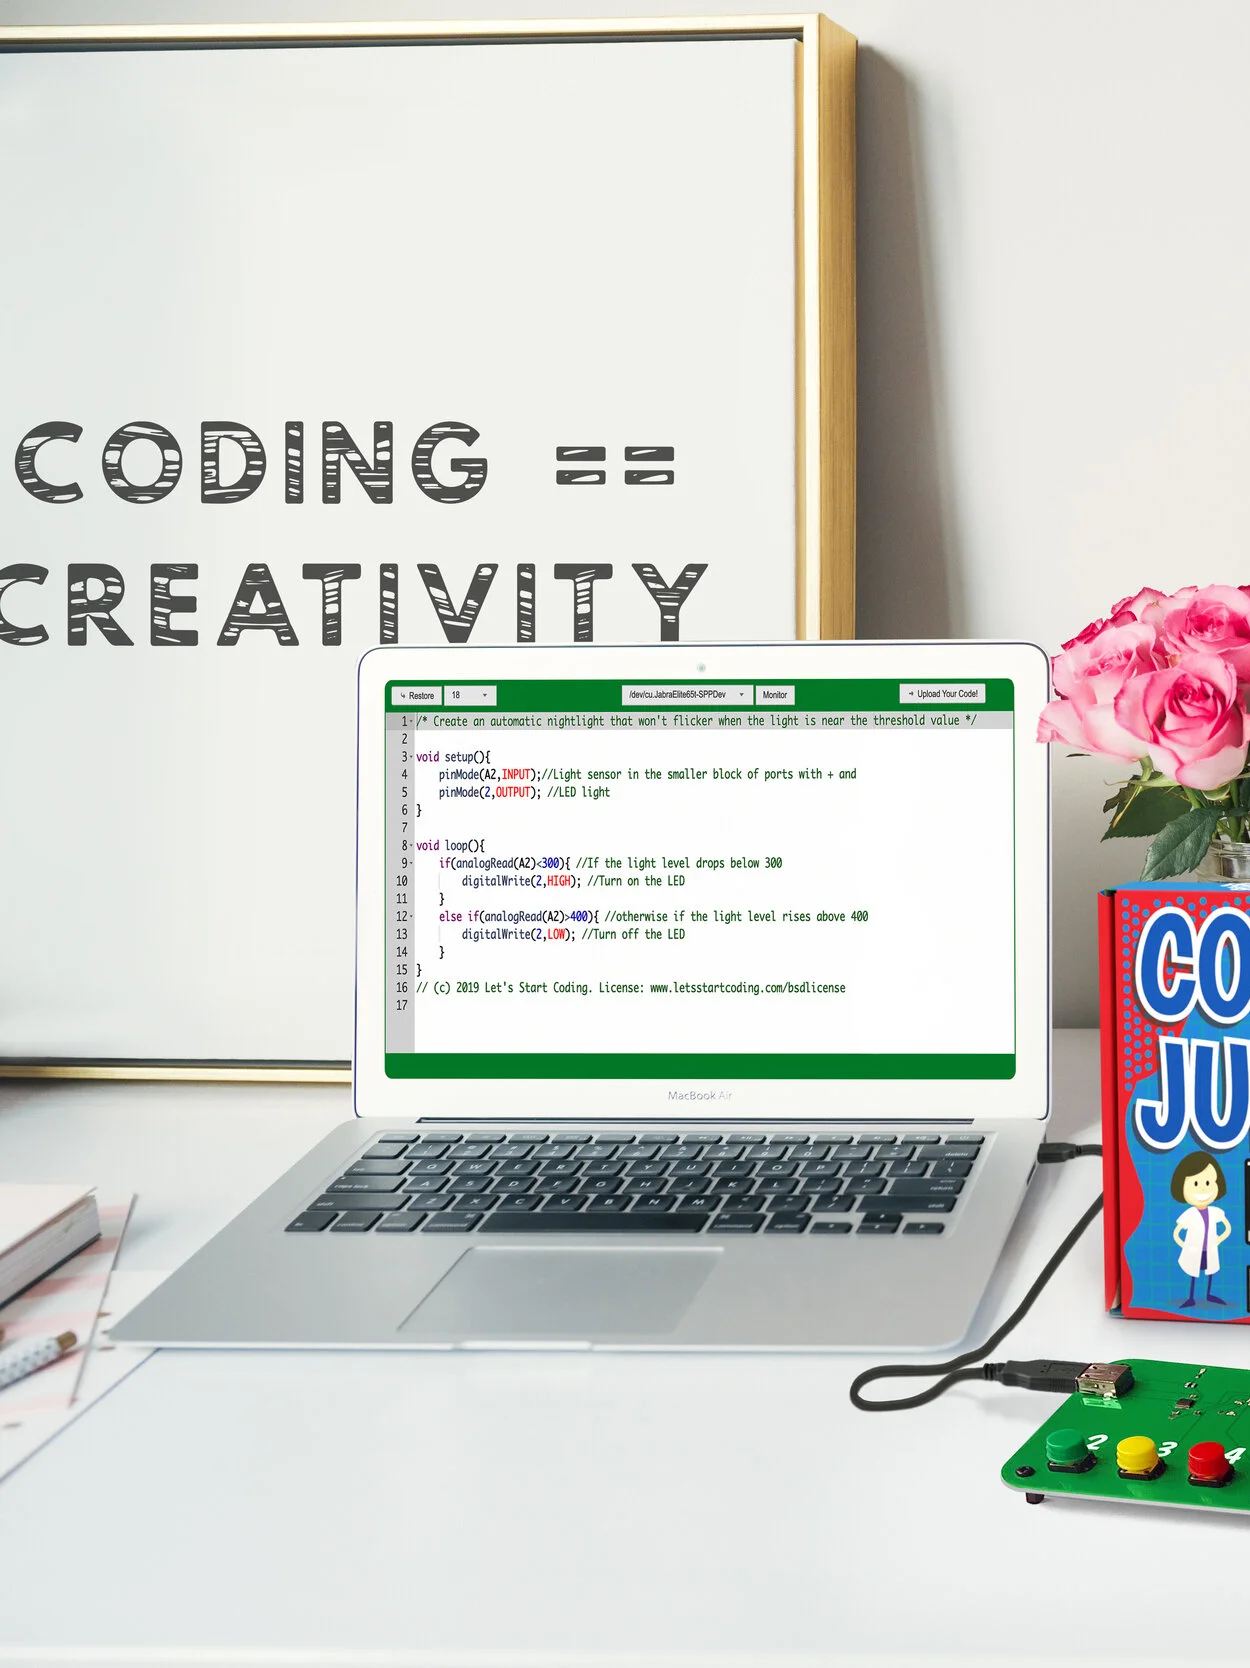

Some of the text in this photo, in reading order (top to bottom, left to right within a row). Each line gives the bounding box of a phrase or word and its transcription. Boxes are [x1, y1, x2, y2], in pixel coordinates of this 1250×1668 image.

[14, 420, 675, 505] CODING ==
[0, 563, 709, 647] CREATIVITY
[409, 691, 435, 700] Restore
[451, 690, 461, 699] 18
[628, 689, 727, 699] /dev/cu.JabraElite65t-SPPDev
[762, 690, 788, 699] Monitor
[917, 689, 978, 699] Upload Your Code!
[401, 715, 408, 727] 1
[434, 716, 467, 726] Create
[473, 718, 484, 726] an
[491, 715, 541, 726] automatic
[548, 715, 604, 729] nightlight
[610, 715, 633, 726] that
[638, 715, 667, 726] won't
[673, 715, 713, 726] flicker
[719, 715, 741, 726] when
[748, 715, 764, 726] the
[770, 715, 798, 728] light
[805, 715, 816, 725] is
[822, 717, 844, 726] near
[851, 715, 867, 725] the
[873, 714, 925, 725] threshold
[931, 714, 959, 725] value
[401, 732, 408, 745] 2
[401, 750, 490, 764] 3 void setup(){
[401, 768, 856, 782] 4 pinMode(A2,INPUT);//Light sensor in the smaller block of ports with + and
[401, 786, 610, 800] 5 pinMode(2,OUTPUT); //LED light
[401, 803, 422, 817] 6 }
[401, 821, 408, 833] 7
[401, 839, 485, 853] 8 void loop(){
[401, 856, 782, 871] 9 if(analogRead(A2)<300){ //If the light level drops below 300
[396, 874, 685, 889] 10 digitalWrite(2,HIGH); //Turn on the LED
[396, 892, 444, 906] 11 }
[396, 910, 868, 924] 12 else if(analogRead(A2)>400){ //otherwise if the light level rises above 400
[396, 927, 685, 942] 13 digitalWrite(2,LOW); //Turn off the LED
[396, 945, 444, 959] 14 }
[396, 963, 422, 977] 15 }
[396, 981, 845, 995] 16 // (c) 2019 Let's Start Coding. License: www.letsstartcoding.com/bsdlicense
[396, 999, 408, 1011] 17
[668, 1091, 733, 1101] MacBook Air
[1086, 1434, 1108, 1450] 2
[1158, 1441, 1178, 1457] 3
[1224, 1447, 1247, 1464] 4
